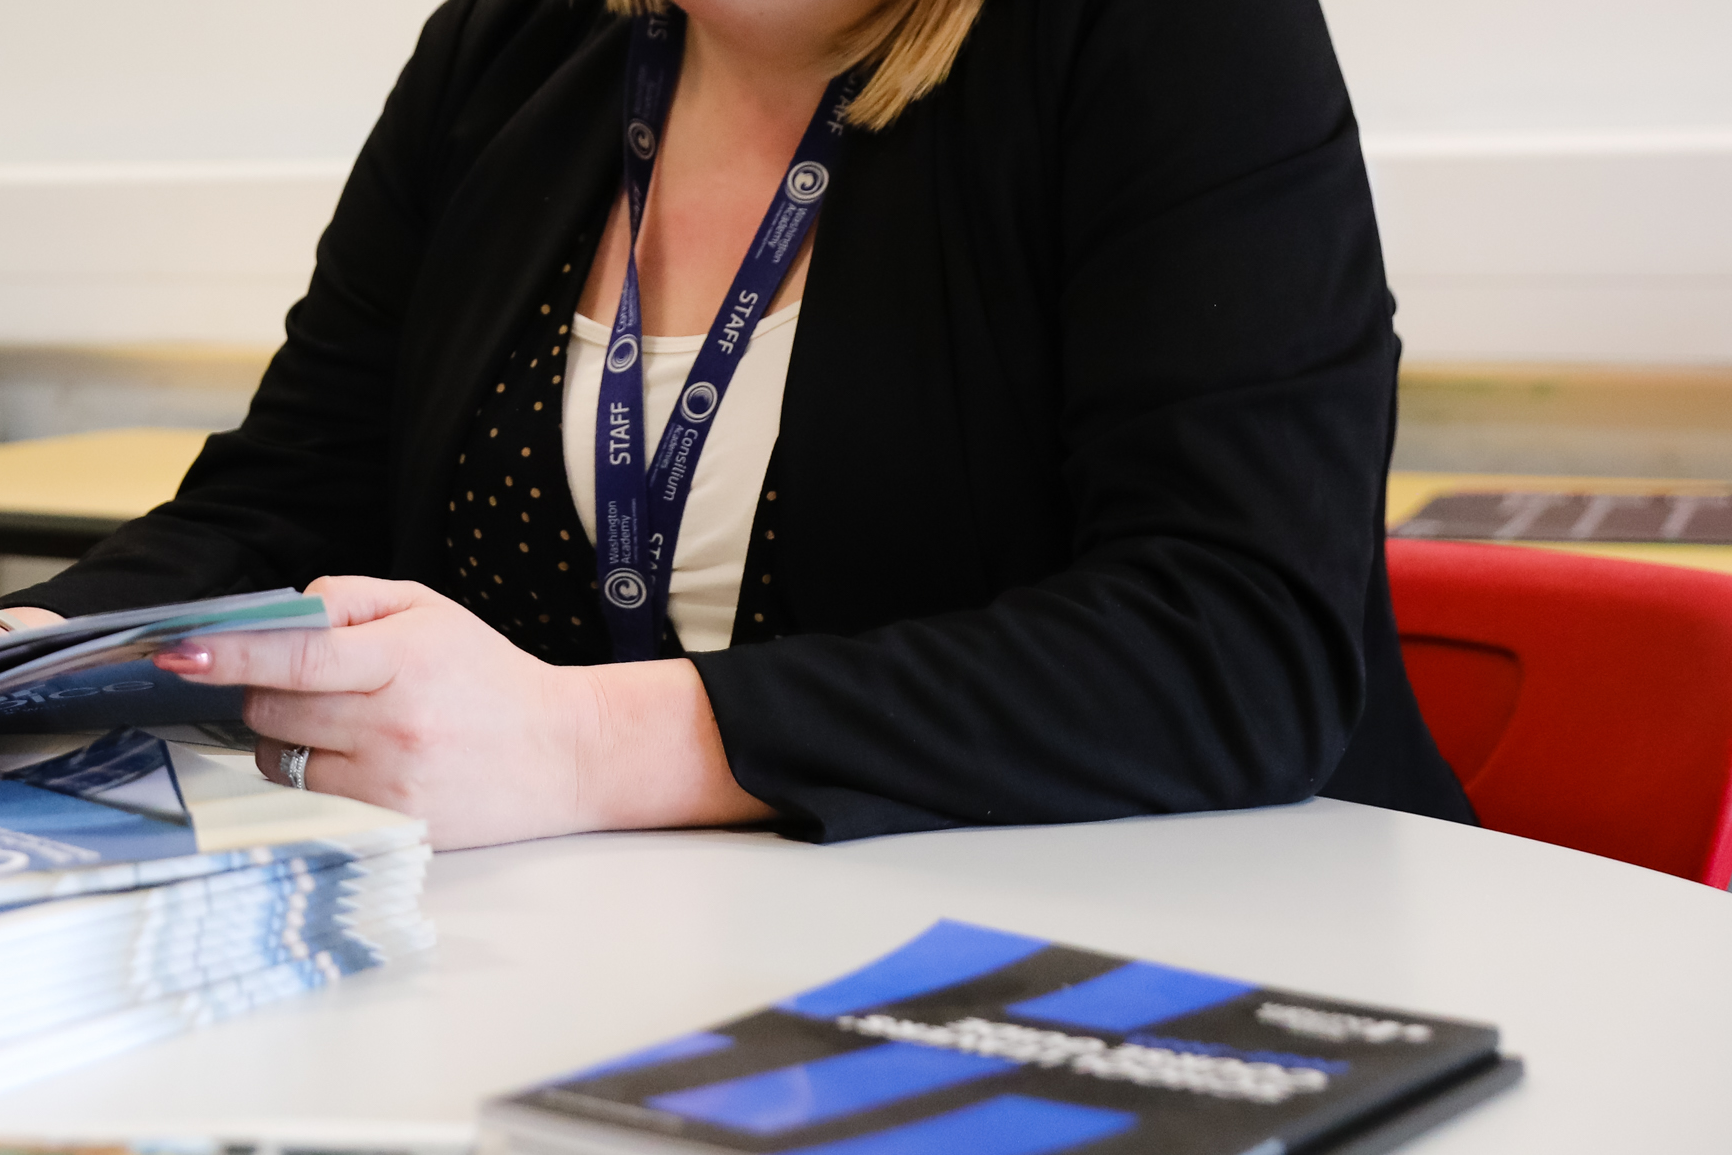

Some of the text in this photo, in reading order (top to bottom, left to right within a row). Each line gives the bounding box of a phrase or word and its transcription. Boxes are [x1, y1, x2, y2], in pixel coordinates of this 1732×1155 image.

[767, 202, 798, 249] Academy
[772, 207, 808, 264] Washington
[717, 289, 759, 355] STAFF
[609, 401, 631, 465] STAFF
[659, 424, 685, 469] Academies
[663, 428, 700, 502] Consilium
[608, 500, 621, 565] Washington
[620, 514, 632, 565] Academy
